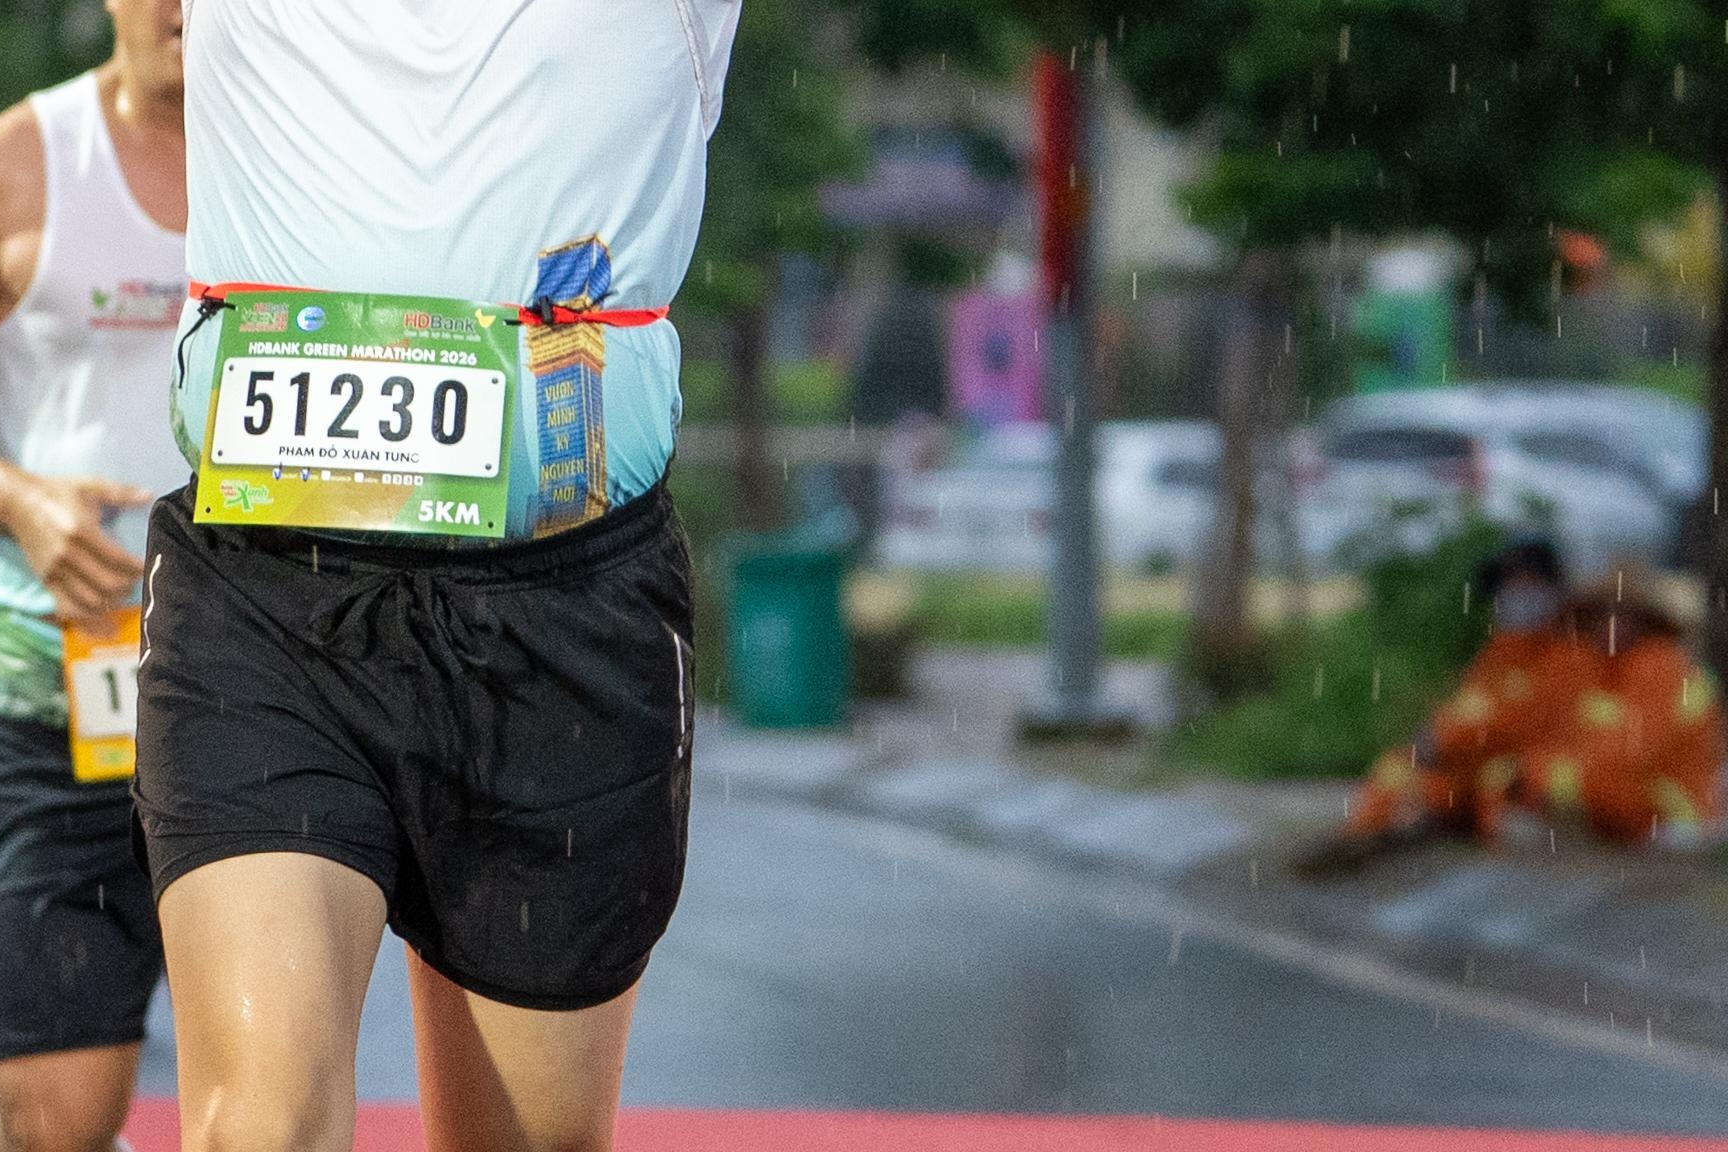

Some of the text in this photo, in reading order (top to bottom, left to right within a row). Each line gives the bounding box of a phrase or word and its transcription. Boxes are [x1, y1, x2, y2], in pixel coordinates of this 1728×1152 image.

[403, 311, 475, 334] HDBank
[248, 342, 478, 366] HDBANK GREEN MARATHON 2026
[243, 370, 469, 446] 51230
[417, 499, 481, 526] 5KM
